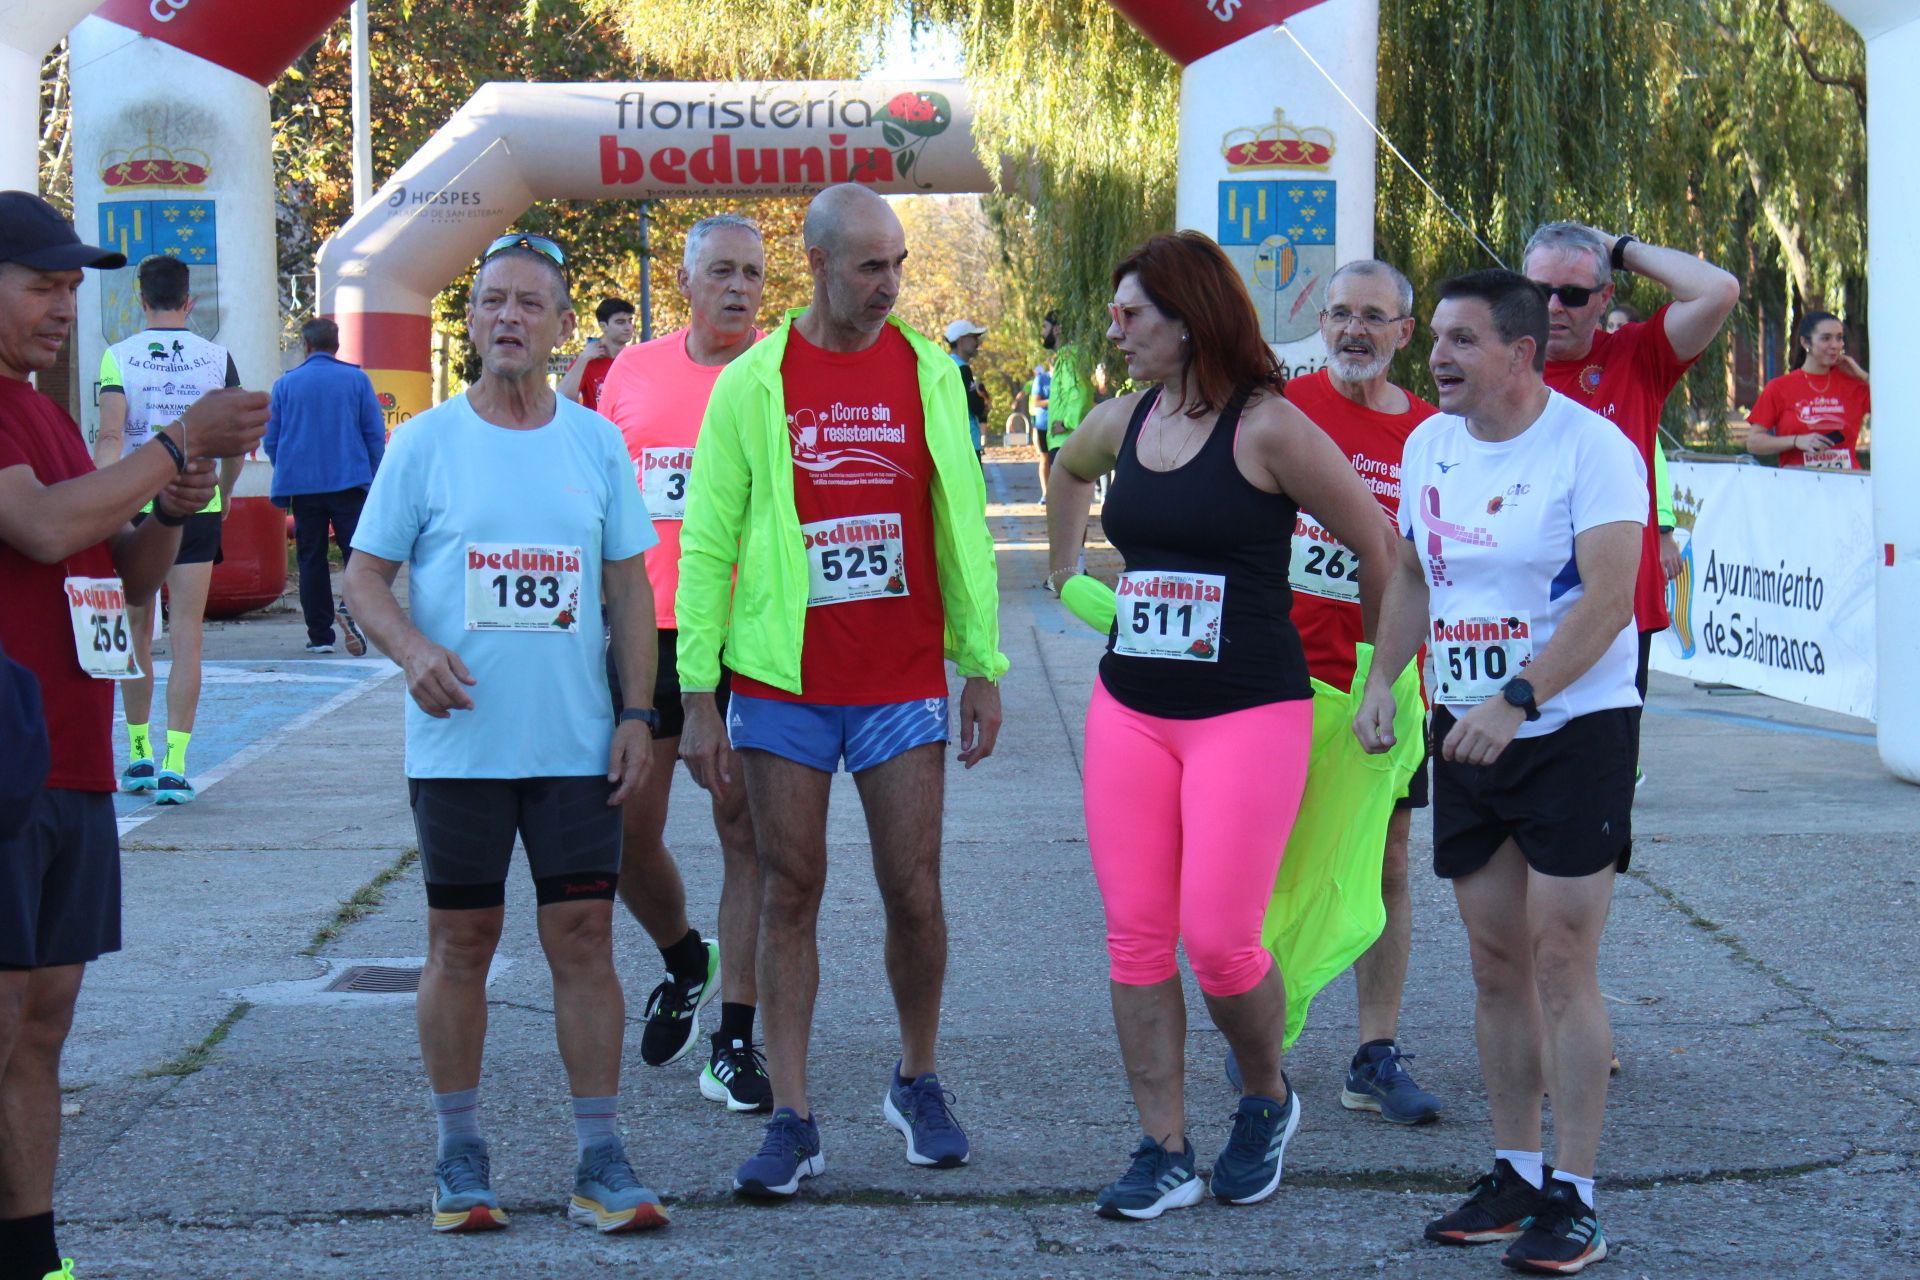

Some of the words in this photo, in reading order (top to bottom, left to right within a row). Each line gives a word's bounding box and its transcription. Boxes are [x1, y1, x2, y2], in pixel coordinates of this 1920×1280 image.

[615, 91, 872, 129] floristería
[599, 134, 894, 185] bedunia
[411, 191, 481, 205] HOSPES
[128, 356, 141, 368] La
[831, 402, 869, 423] ¡Corre
[871, 403, 891, 421] sin
[823, 423, 905, 443] resistencias!
[468, 549, 580, 572] bedunia
[821, 545, 888, 581] 525
[492, 575, 560, 608] 183
[1117, 576, 1222, 602] bedunia
[1703, 549, 1824, 612] Ayunamiento
[90, 614, 128, 653] 256
[1132, 602, 1193, 637] 511
[1433, 618, 1529, 642] bedunia
[1703, 610, 1726, 656] de
[1727, 612, 1825, 676] Salamanca
[1448, 645, 1507, 681] 510
